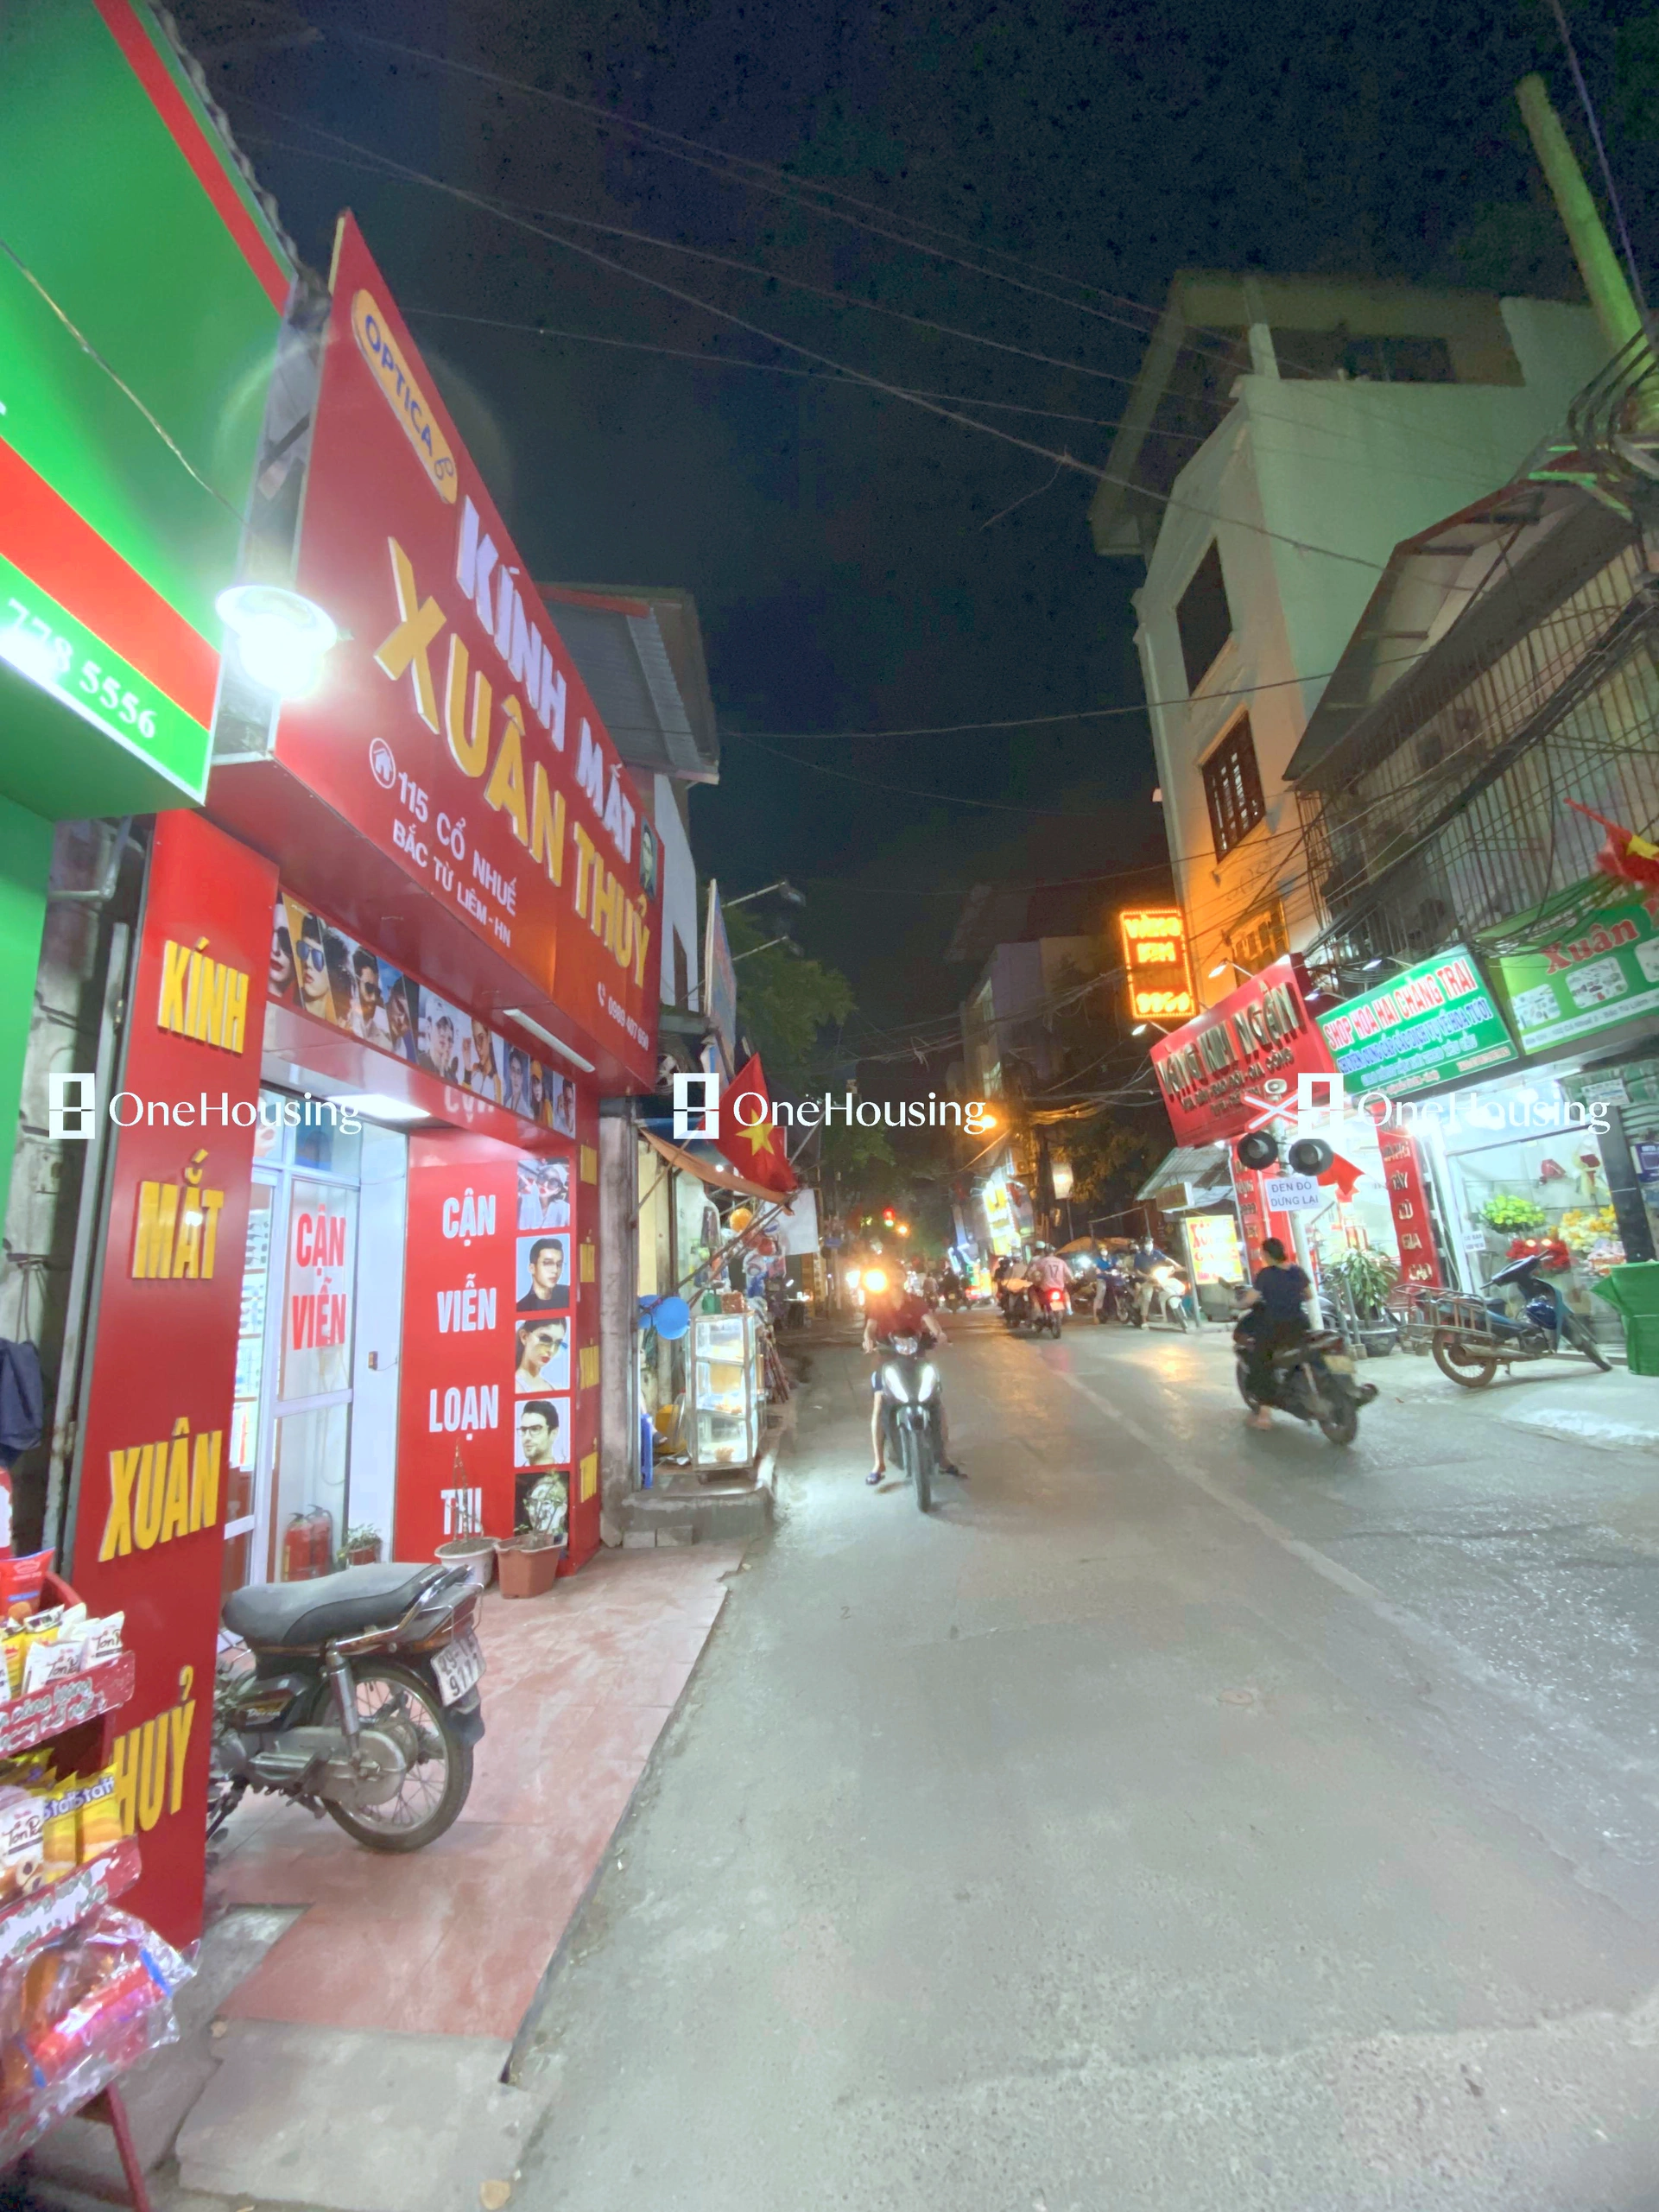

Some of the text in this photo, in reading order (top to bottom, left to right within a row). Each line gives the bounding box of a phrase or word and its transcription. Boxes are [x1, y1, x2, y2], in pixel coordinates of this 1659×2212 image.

[364, 314, 434, 458] OPTICA
[79, 661, 157, 739] 5556
[373, 536, 566, 887] XUÂN
[456, 495, 636, 864] KÍNH MẮT
[393, 818, 428, 868] BẮC
[434, 856, 454, 892] TỪ
[457, 882, 487, 926] LIÊM
[494, 919, 511, 948] HN
[398, 772, 517, 917] 115 CỔ NHUẾ
[1540, 919, 1640, 975] Xuân
[157, 936, 250, 1055] KÍNH
[1323, 957, 1479, 1051] SHOP HOA HAI CHÀNG TRAI
[132, 1148, 224, 1280] MẮT
[442, 1188, 497, 1246] CẬN
[1296, 1178, 1313, 1191] ĐỎ
[1302, 1195, 1319, 1207] LẠI
[297, 1203, 346, 1277] CẬN
[1409, 1263, 1433, 1281] CAO
[292, 1277, 346, 1351] VIỄN
[437, 1274, 498, 1334] VIỄN
[428, 1384, 499, 1441] LOẠN
[98, 1417, 223, 1562] XUÂN
[111, 1665, 196, 1836] HUỶ
